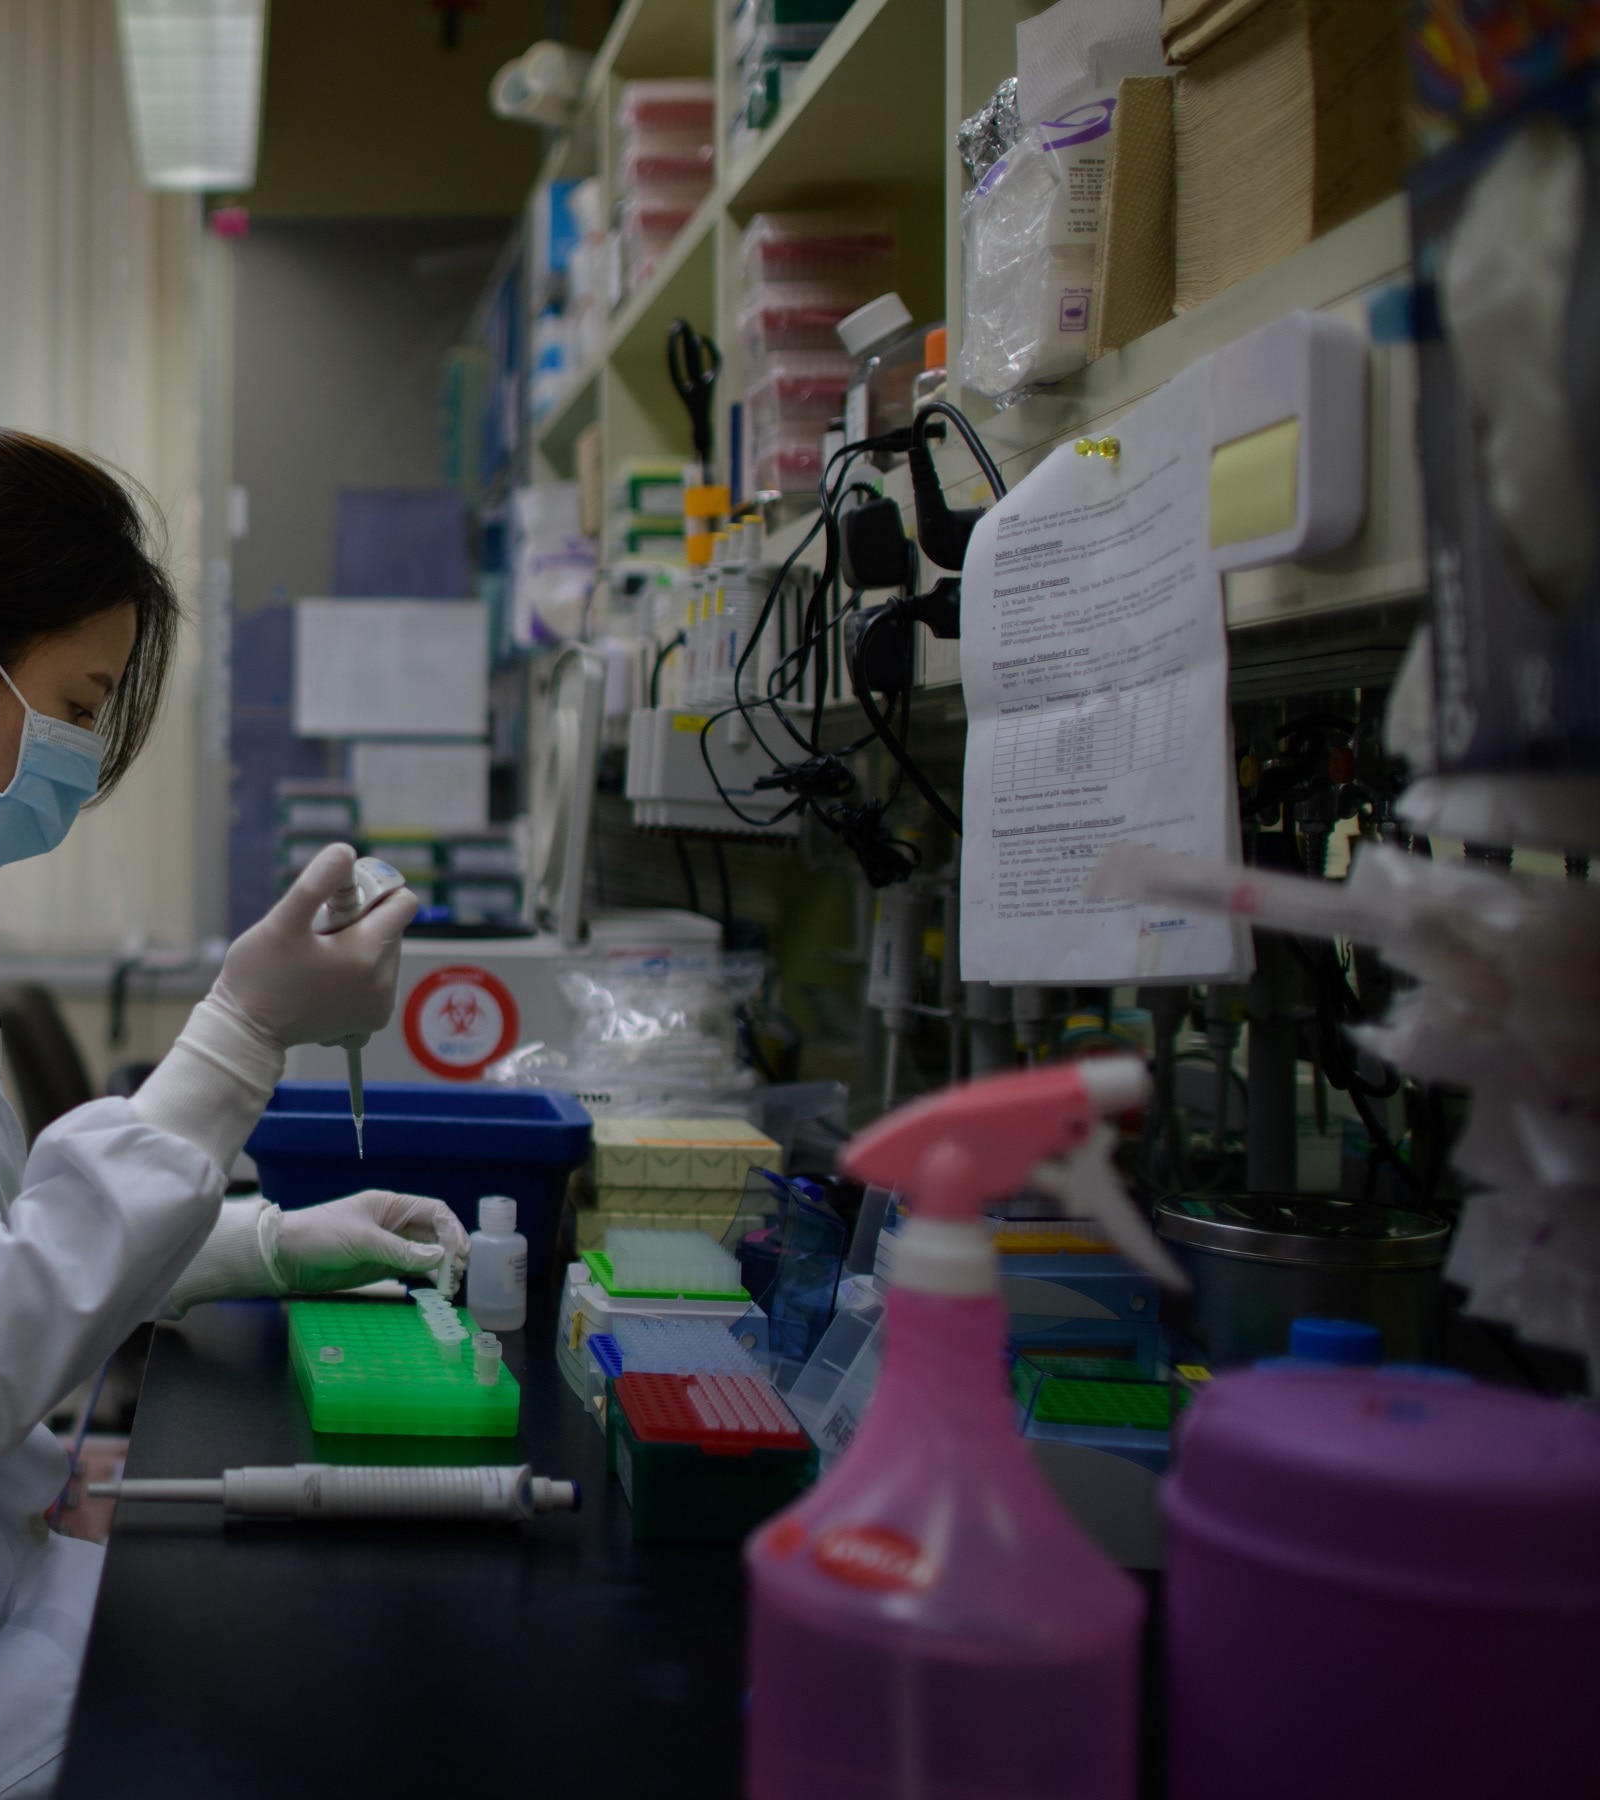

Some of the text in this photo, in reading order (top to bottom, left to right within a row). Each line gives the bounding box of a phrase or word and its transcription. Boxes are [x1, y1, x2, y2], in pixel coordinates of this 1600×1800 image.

[999, 513, 1020, 526] Storage
[995, 540, 1062, 561] Safety Considerations
[993, 577, 1070, 598] Preparation of Reagents
[992, 648, 1089, 670] Preparation of Standard Curve
[1001, 705, 1023, 714] Standard
[992, 827, 1023, 837] Preparation
[1024, 825, 1035, 834] and
[1036, 822, 1070, 832] Inactivation
